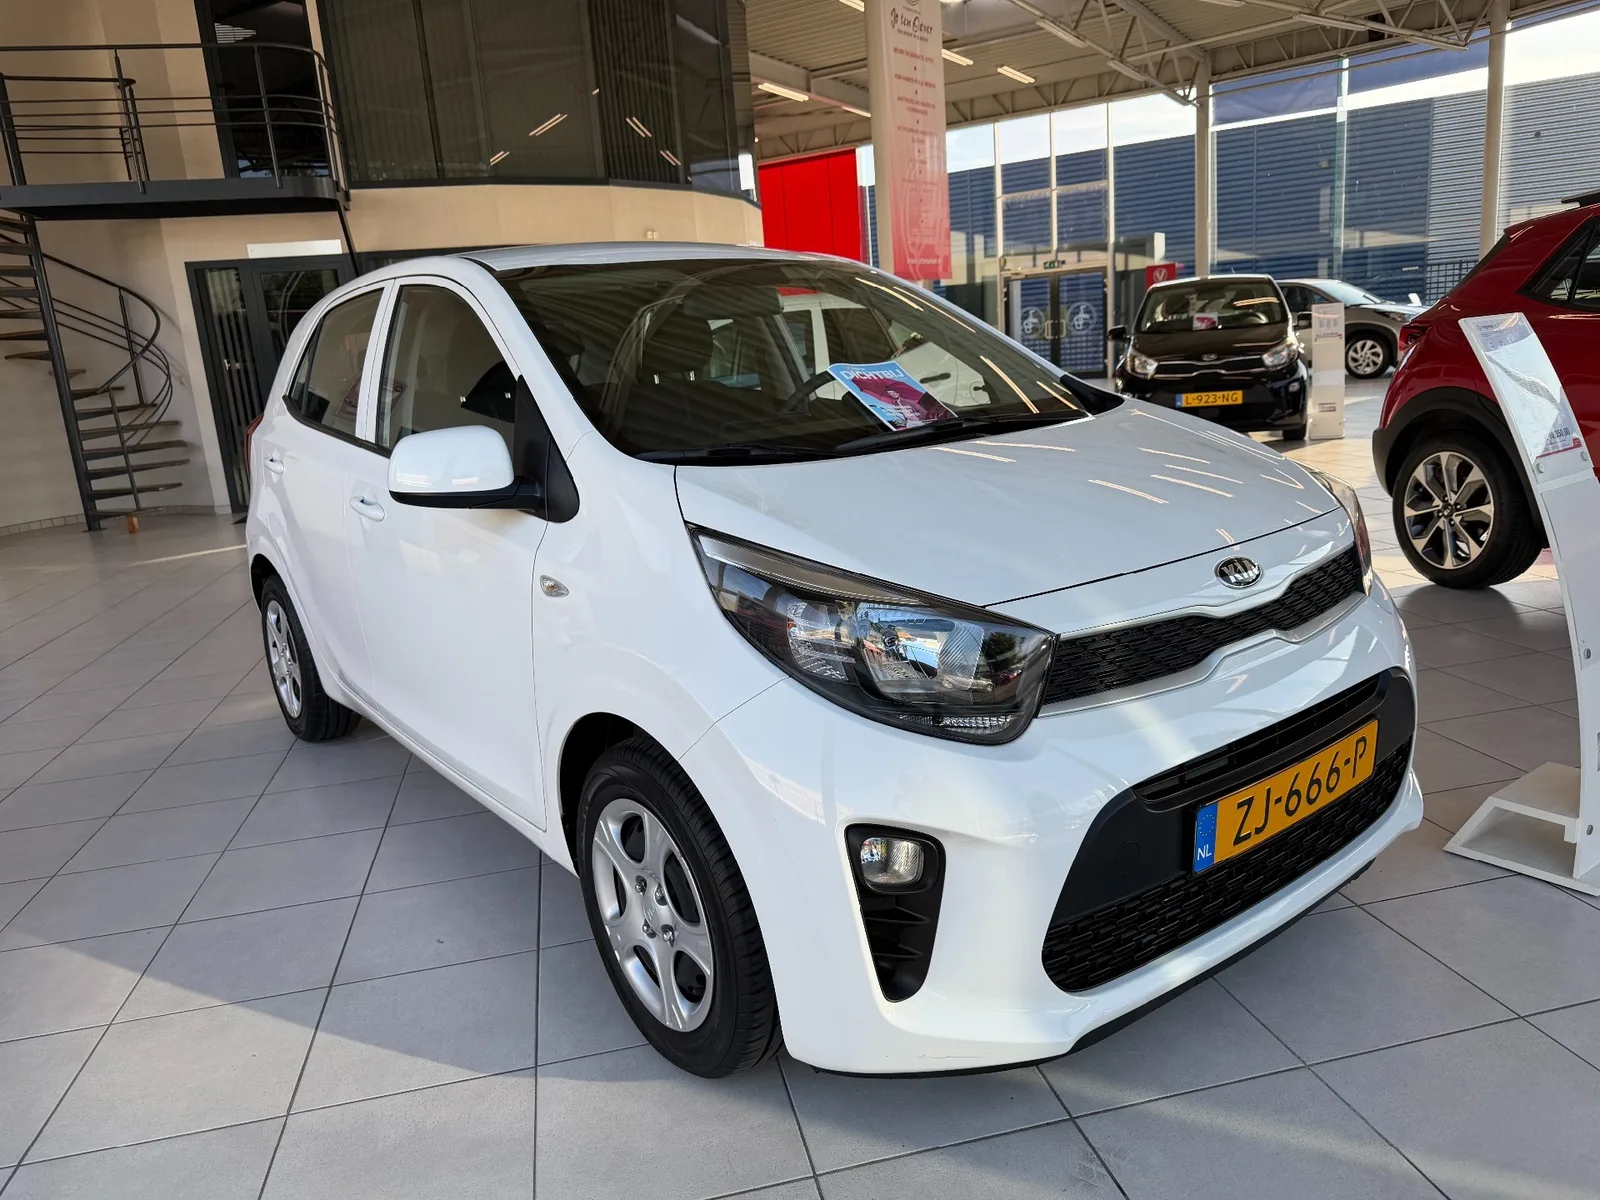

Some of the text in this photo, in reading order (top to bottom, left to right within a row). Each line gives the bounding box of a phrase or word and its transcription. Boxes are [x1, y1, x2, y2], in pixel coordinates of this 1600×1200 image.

[840, 368, 905, 380] DICHTBIJ
[1185, 392, 1239, 406] L-923-NG
[1232, 735, 1368, 847] ZJ-666-P
[1197, 844, 1212, 861] NL
